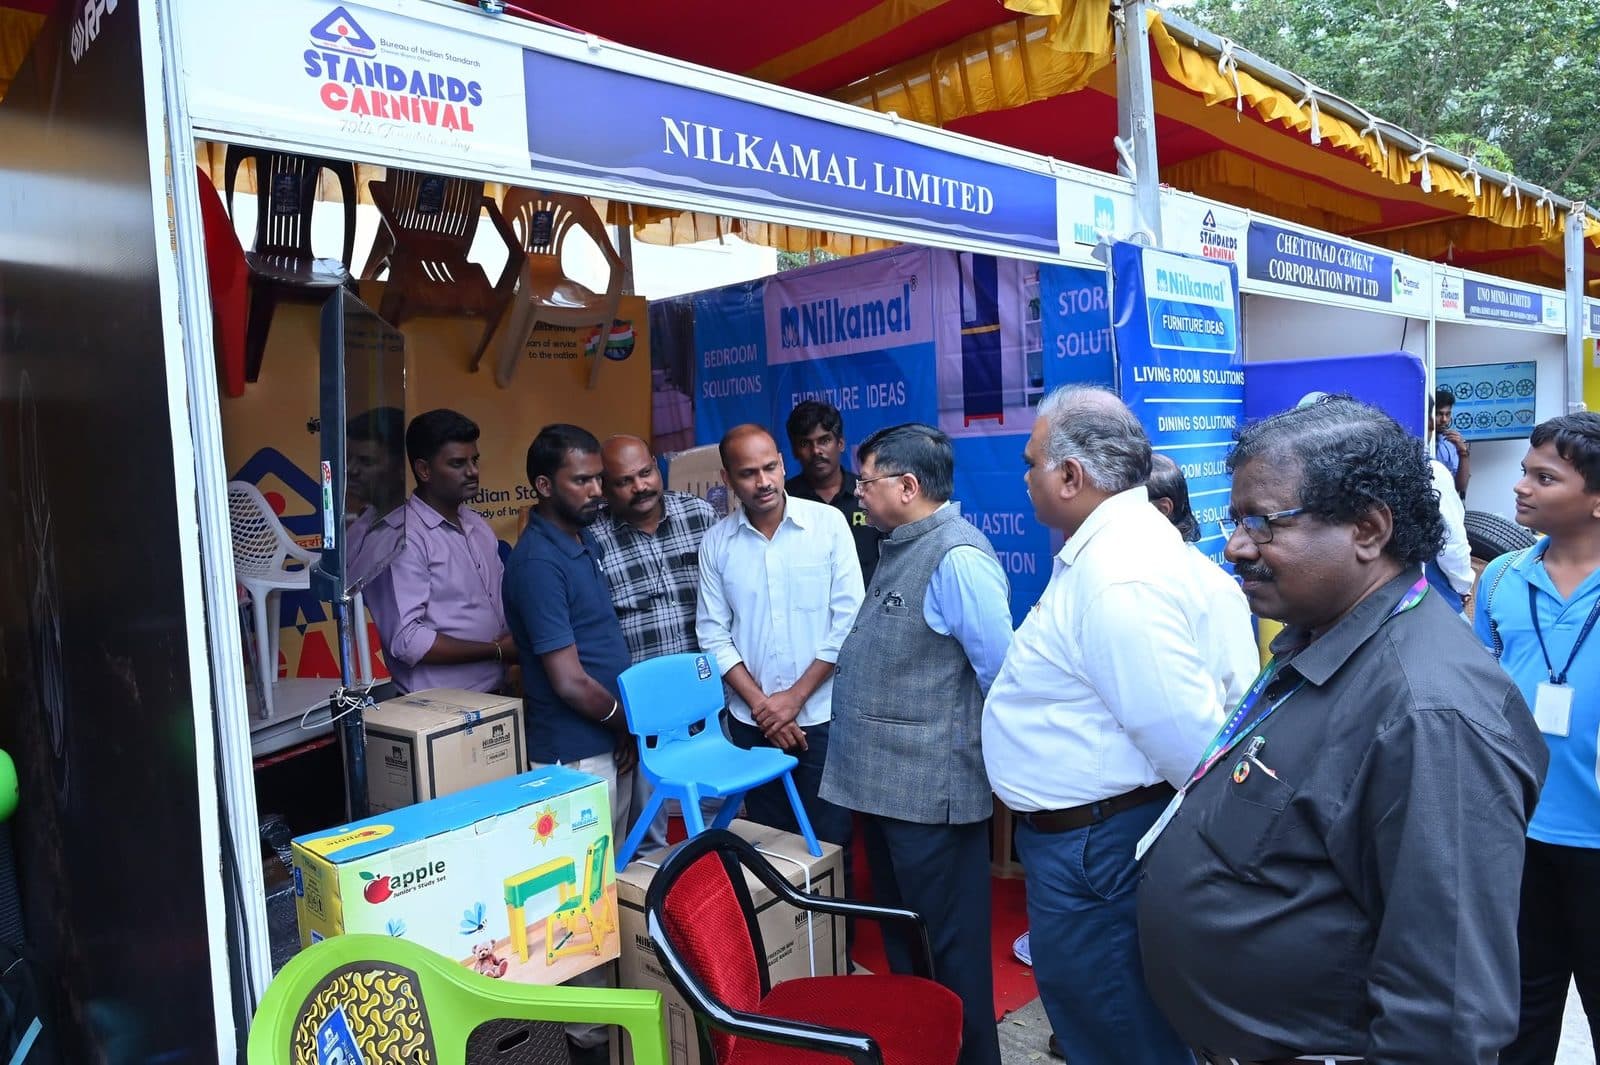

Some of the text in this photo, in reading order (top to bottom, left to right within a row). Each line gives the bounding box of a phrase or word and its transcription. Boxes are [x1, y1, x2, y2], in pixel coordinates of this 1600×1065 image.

[380, 38, 409, 51] Bureau
[420, 47, 444, 59] Indian
[303, 49, 483, 107] STANDARDS
[320, 82, 474, 132] CARNIVAL
[661, 116, 995, 215] NILKAMAL LIMITED
[1200, 231, 1237, 250] STANDARDS
[1276, 233, 1374, 272] CHETTINAD CEMENT
[1202, 245, 1235, 261] CARNIVAL
[1168, 272, 1225, 302] Nilkamal
[1269, 258, 1379, 297] CORPORATION PVT LTD
[1477, 287, 1531, 309] UNO MINDA LIMITED
[802, 283, 912, 347] Nilkamal
[1162, 314, 1225, 335] FURNITURE IDEAS
[528, 350, 578, 359] to the nation
[704, 343, 758, 369] BEDROOM
[702, 375, 762, 399] SOLUTIONS
[1133, 366, 1245, 386] LIVING ROOM SOLUTIONS
[866, 381, 906, 409] IDEAS
[1158, 415, 1237, 431] DINING SOLUTIONS
[497, 507, 507, 517] of
[390, 860, 446, 889] apple
[393, 875, 447, 898] Junior's Study Set
